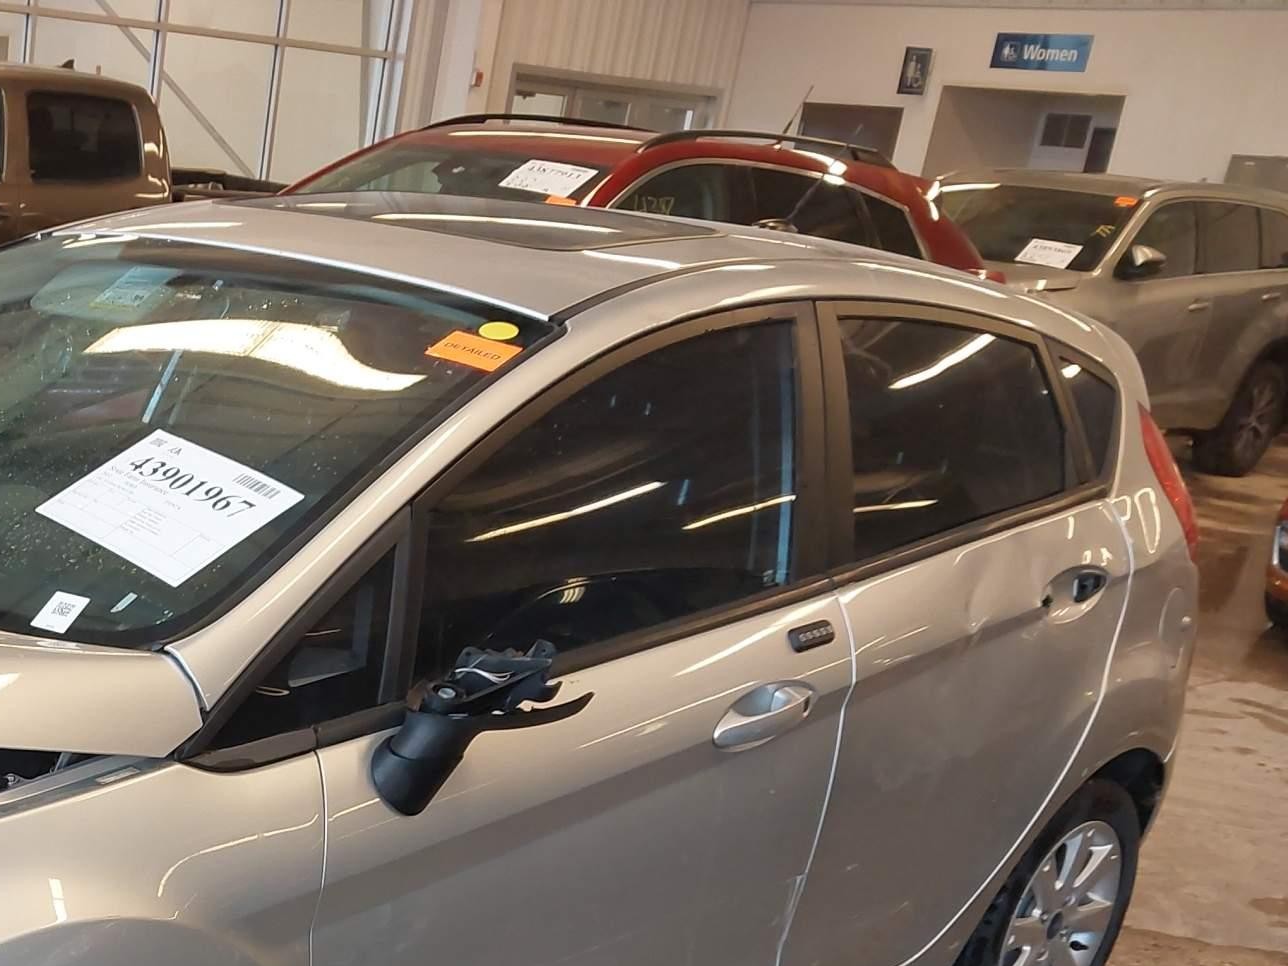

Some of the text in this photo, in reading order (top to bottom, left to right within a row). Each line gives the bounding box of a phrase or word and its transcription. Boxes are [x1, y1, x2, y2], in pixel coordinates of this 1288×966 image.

[1023, 43, 1078, 62] Women
[443, 342, 502, 361] DETAILED
[129, 457, 257, 518] 43901967
